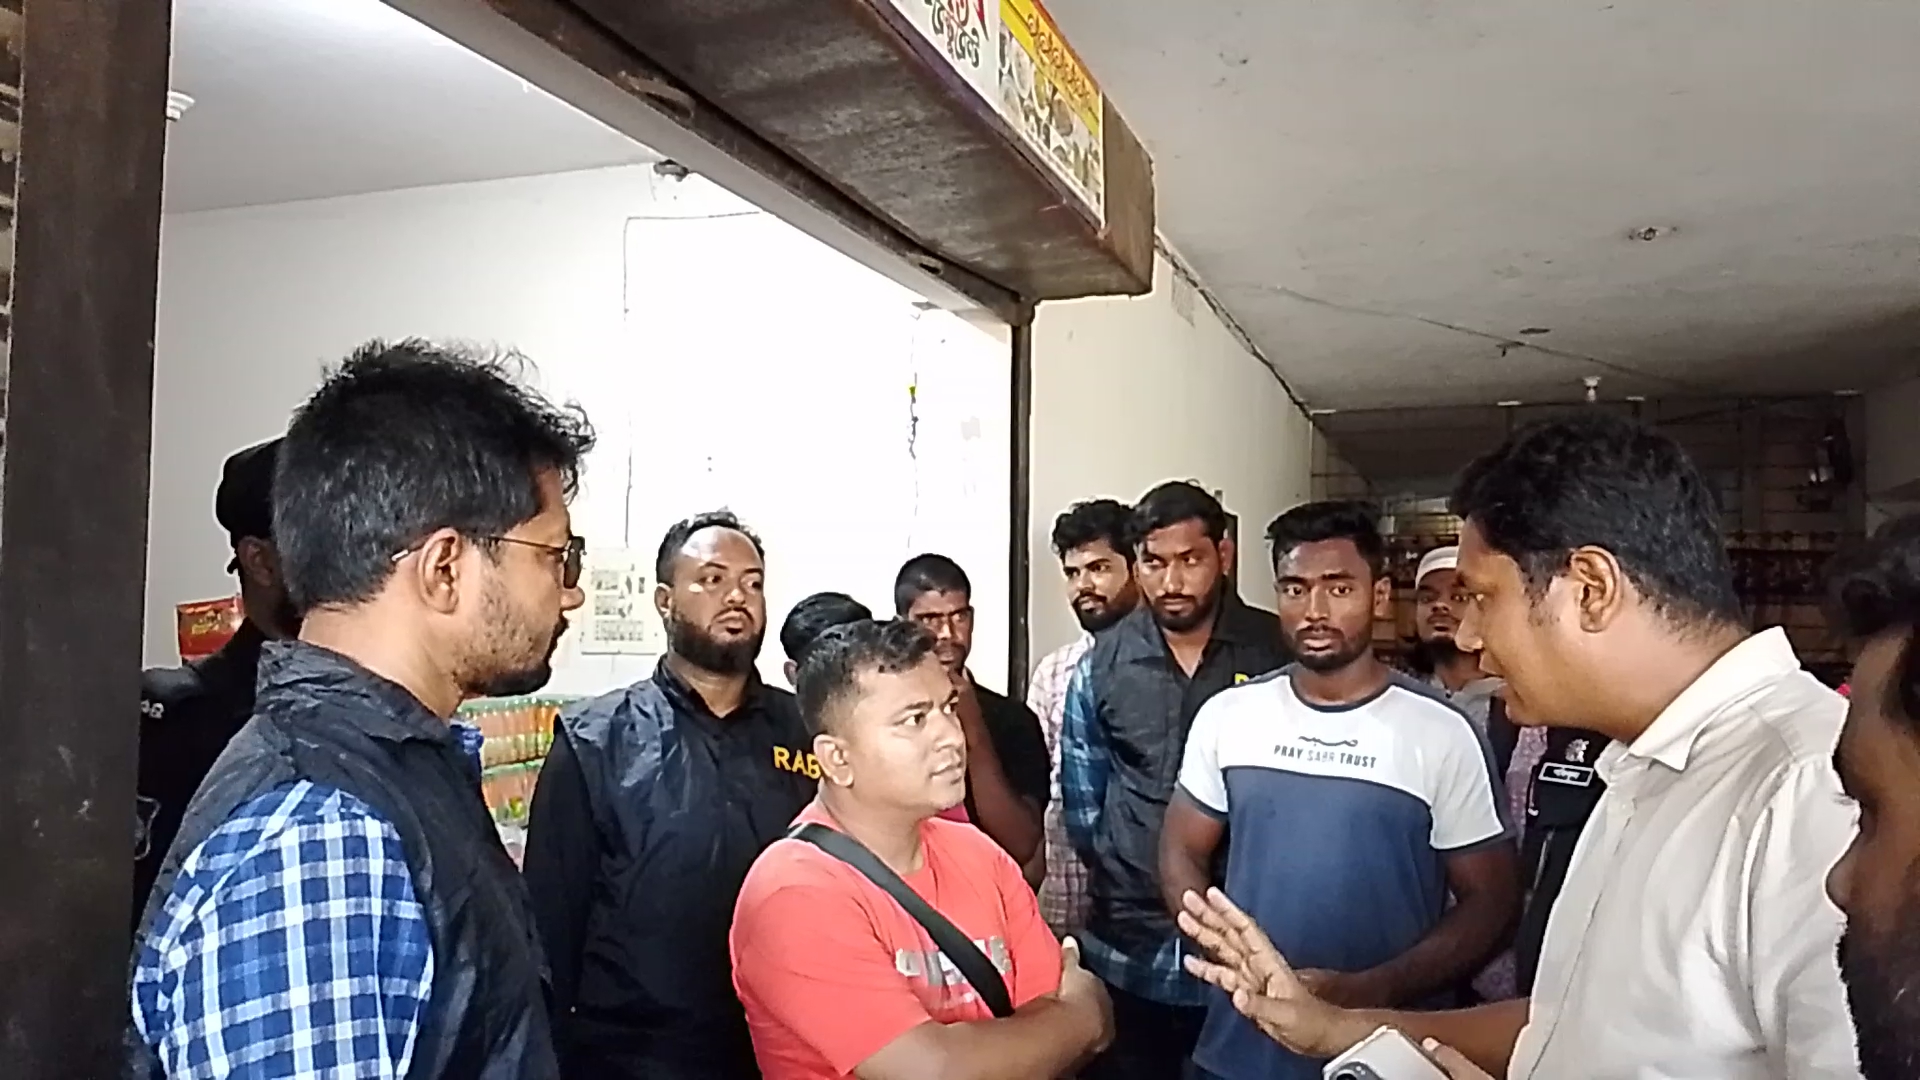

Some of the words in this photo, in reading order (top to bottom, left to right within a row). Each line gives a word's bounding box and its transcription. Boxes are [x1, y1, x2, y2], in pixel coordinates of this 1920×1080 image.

[773, 745, 821, 779] RAB
[1274, 744, 1304, 760] PRAY
[1340, 752, 1377, 769] TRUST
